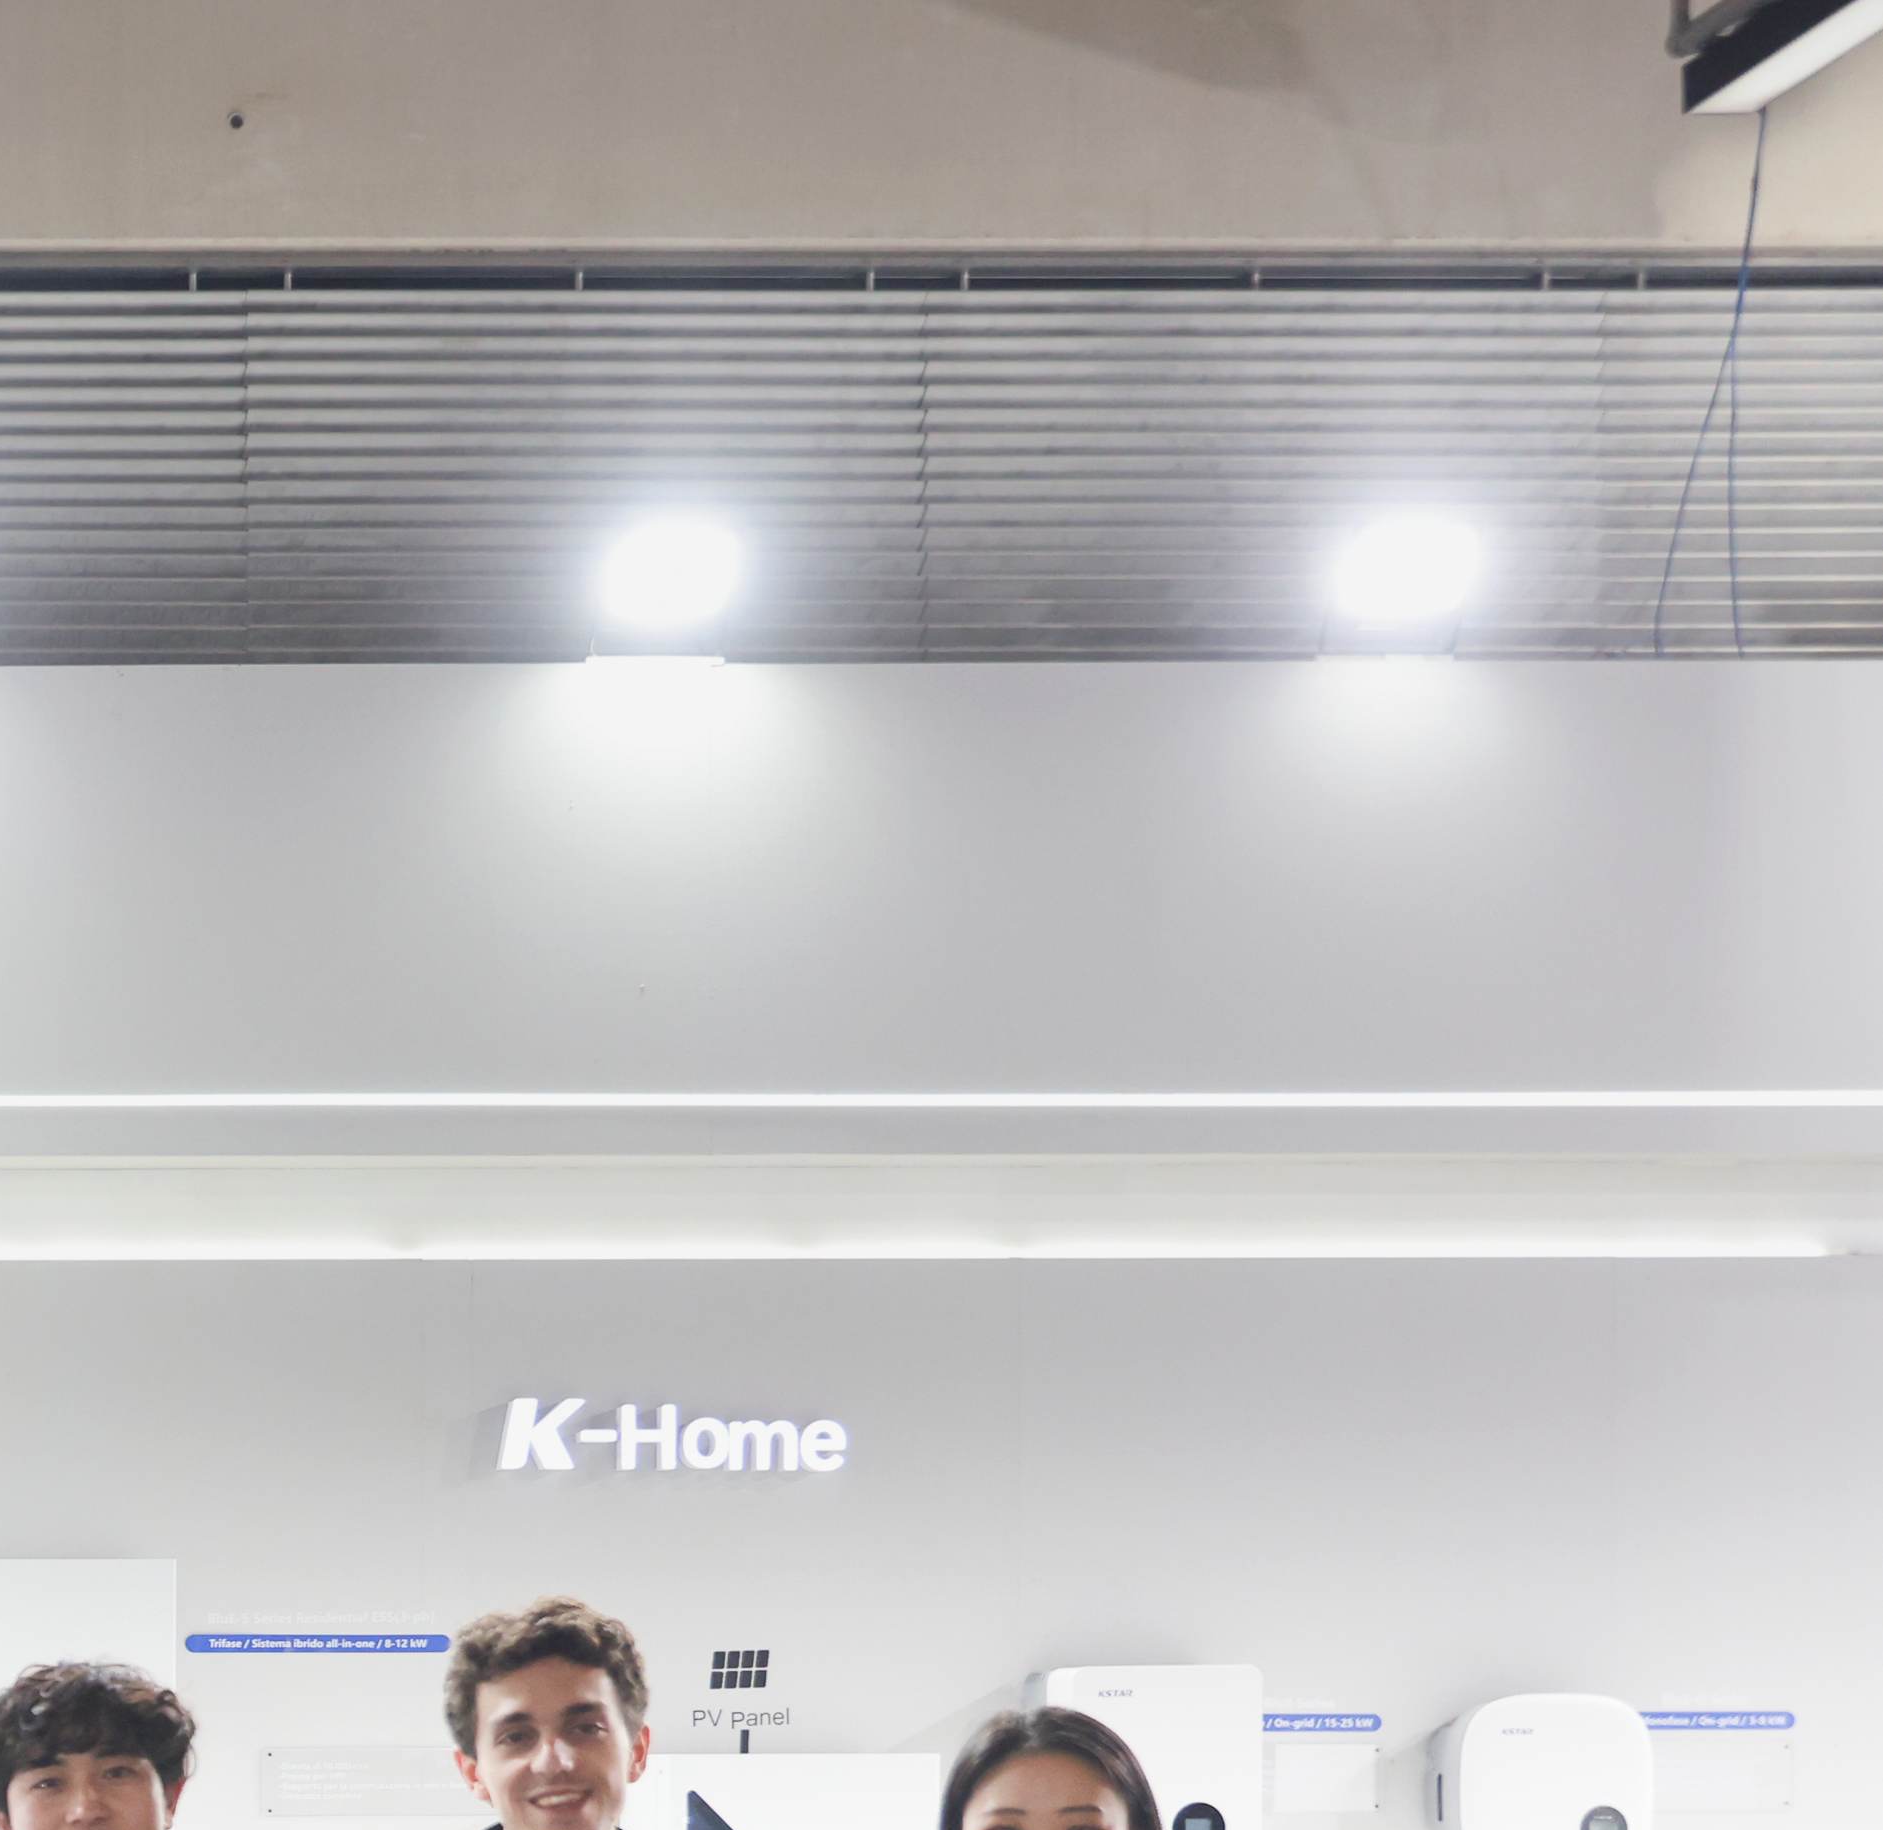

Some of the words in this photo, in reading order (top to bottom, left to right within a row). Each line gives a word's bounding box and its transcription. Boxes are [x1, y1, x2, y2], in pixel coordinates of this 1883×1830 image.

[496, 1397, 847, 1472] K-Home
[209, 1638, 242, 1649] Trifase
[252, 1638, 292, 1649] Sistema
[293, 1638, 324, 1649] ibrido
[325, 1638, 375, 1649] all-in-one
[410, 1638, 428, 1649] kW
[692, 1708, 722, 1727] PV
[730, 1706, 790, 1729] Panel
[1274, 1717, 1315, 1730] On-grid
